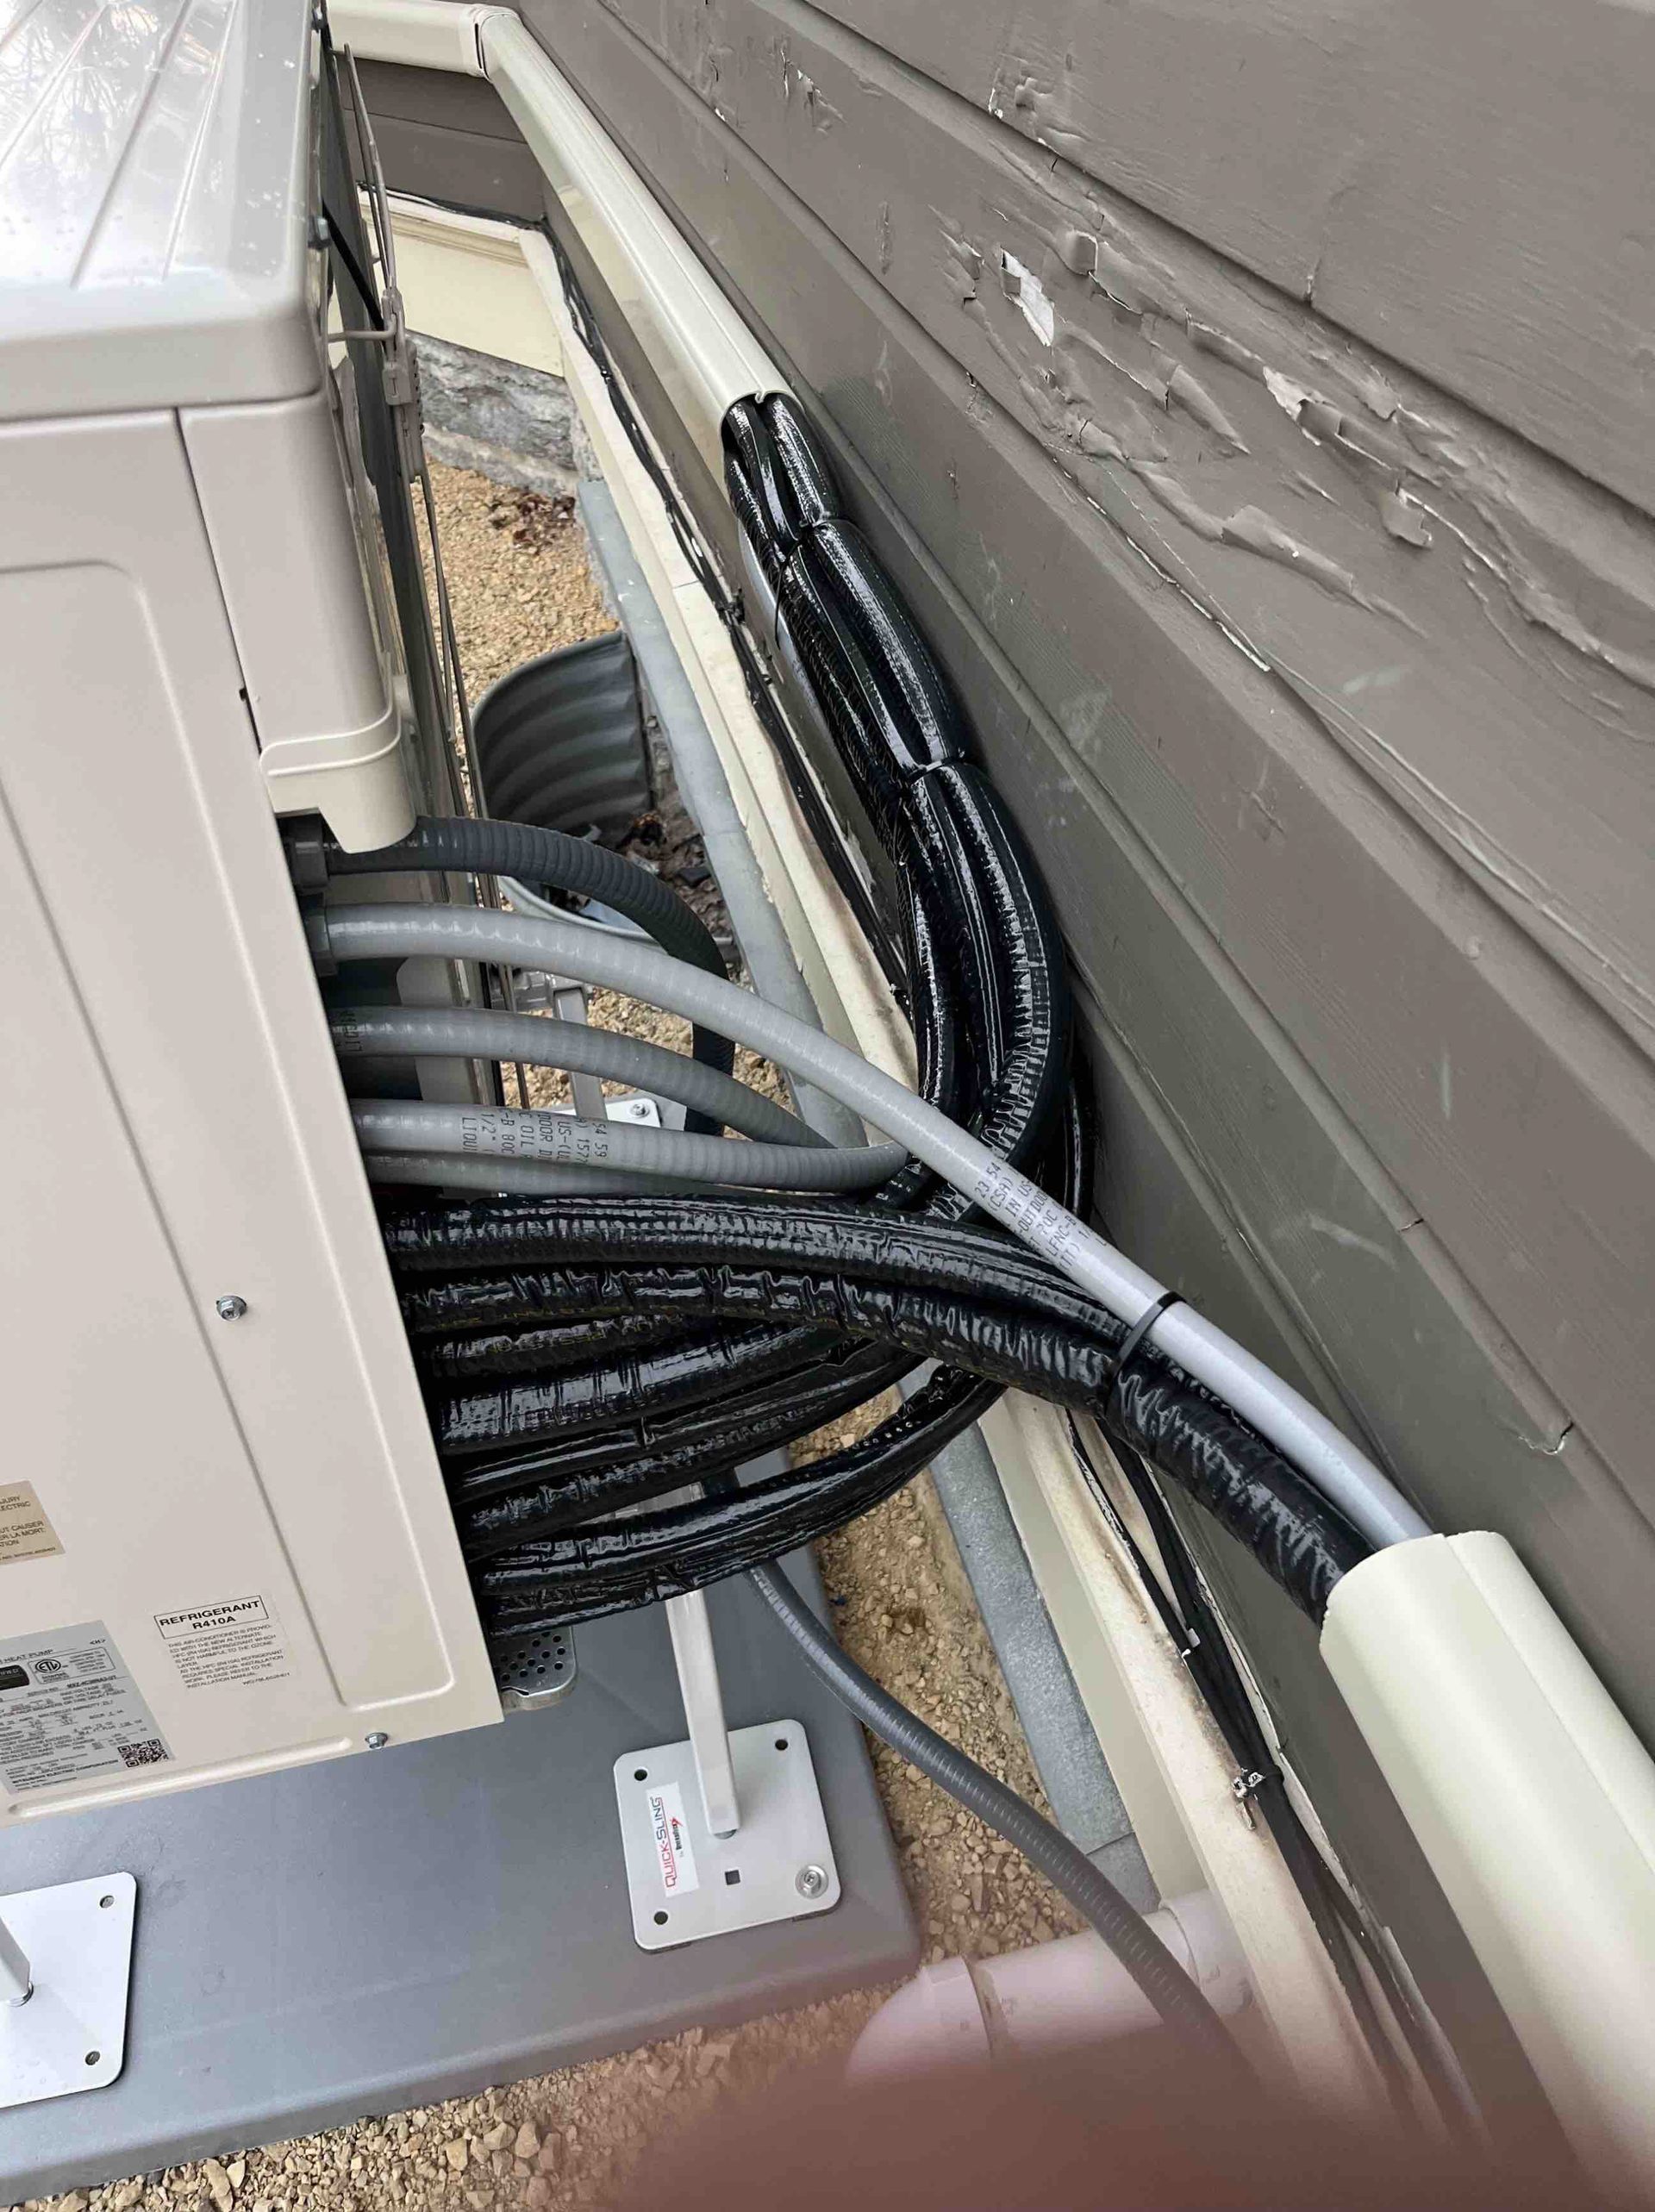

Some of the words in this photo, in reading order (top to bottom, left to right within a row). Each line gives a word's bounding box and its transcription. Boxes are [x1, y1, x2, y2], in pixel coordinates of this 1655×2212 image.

[501, 1134, 515, 1154] 80C
[520, 1125, 535, 1148] OIL
[594, 1142, 609, 1158] 59
[974, 1180, 990, 1198] 23
[986, 1162, 1002, 1179] 54
[987, 1177, 1014, 1211] (CSA)
[1005, 1198, 1021, 1217] IN
[1046, 1215, 1077, 1257] LFNC-B
[159, 1600, 260, 1626] REFRIGERANT
[192, 1615, 236, 1629] R410A
[28, 1649, 53, 1659] PUMP
[649, 1796, 678, 1888] QUICK-SLING
